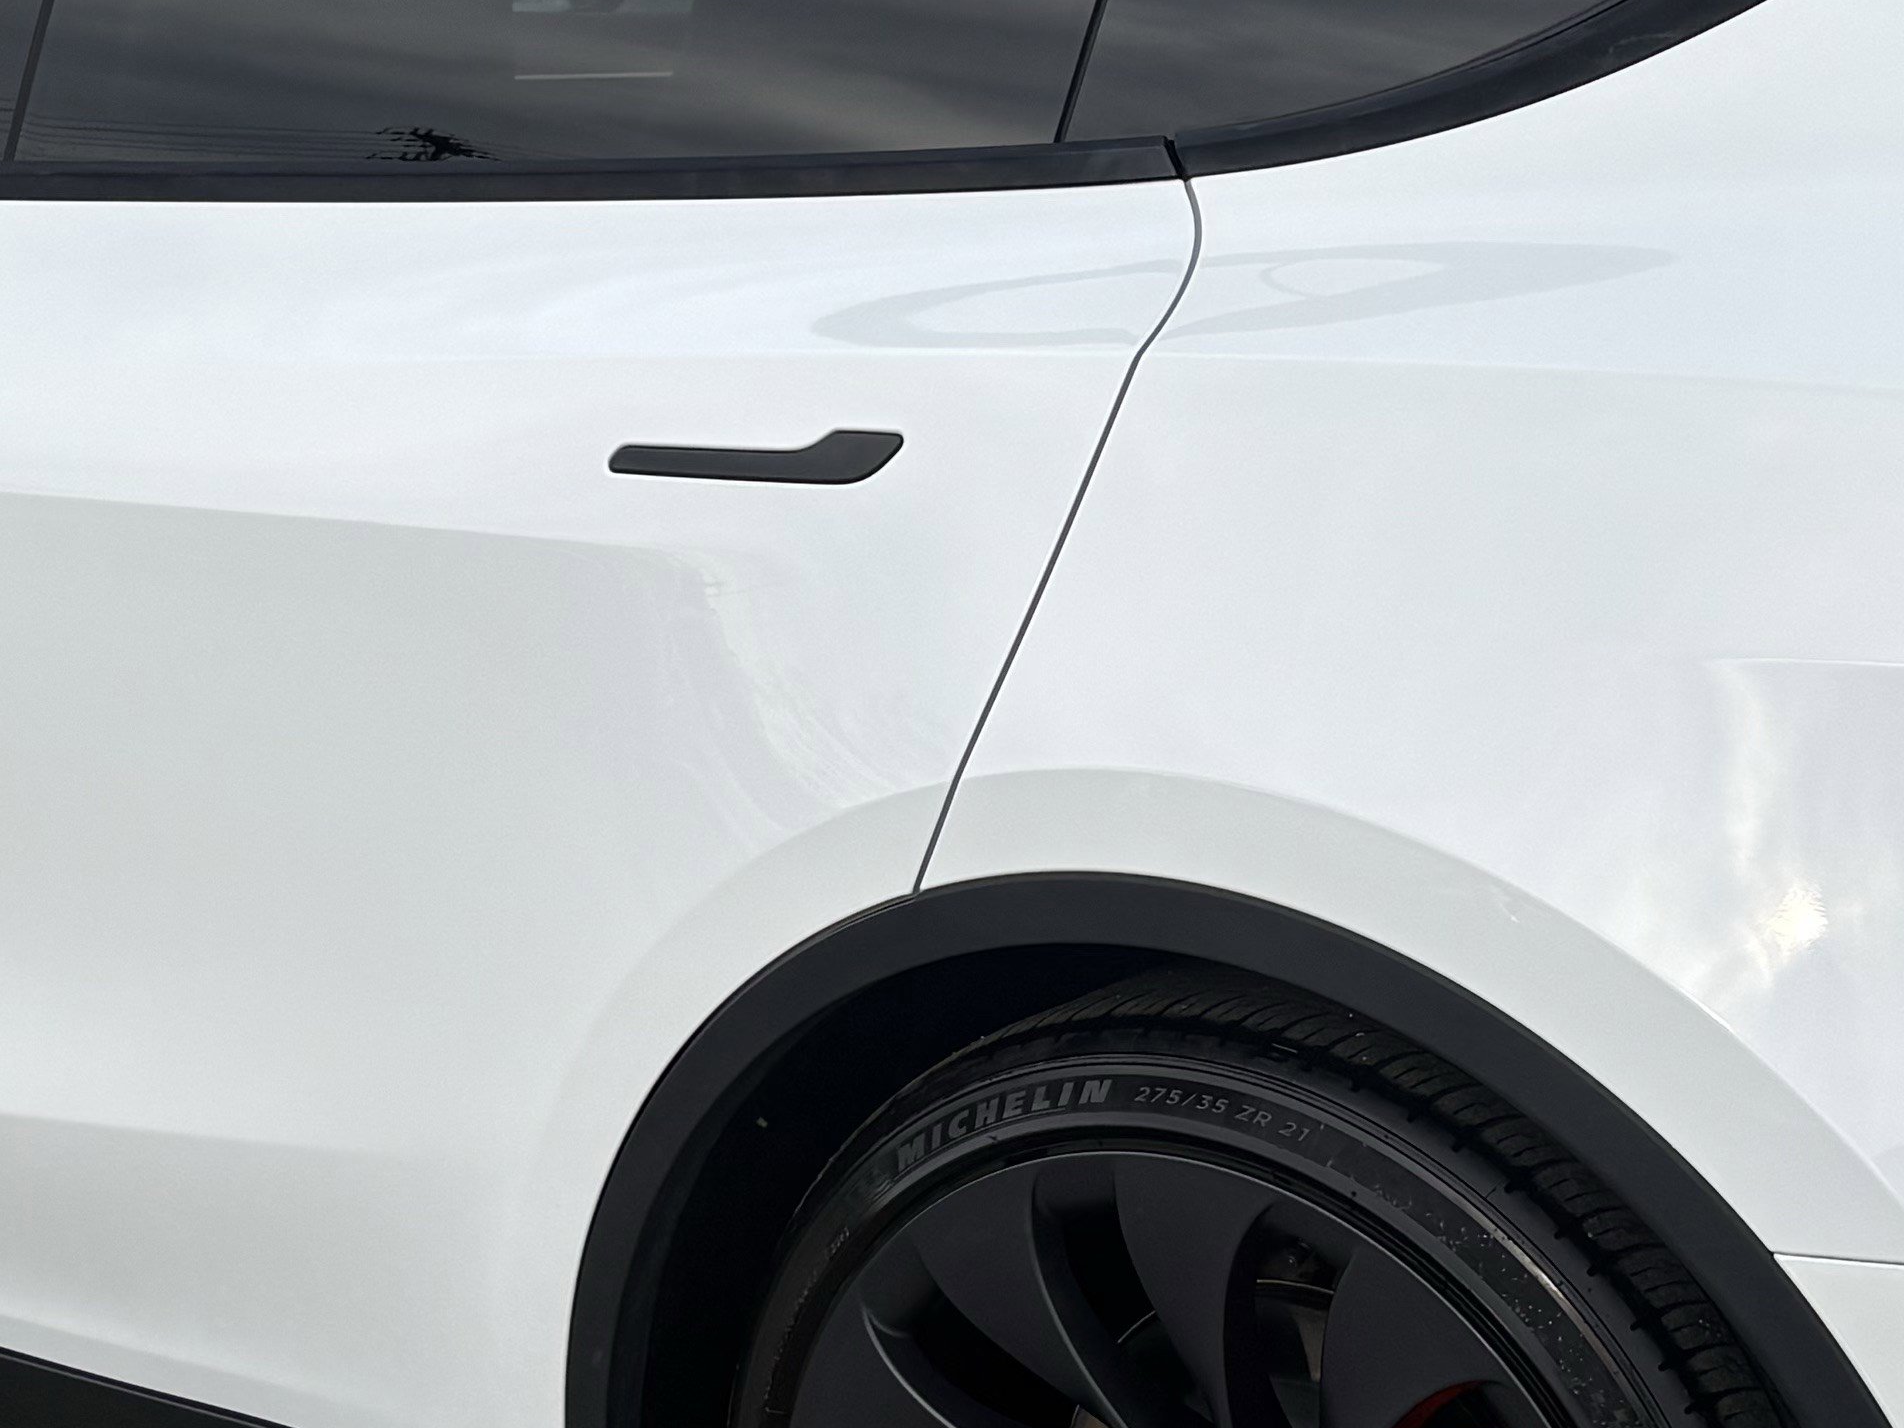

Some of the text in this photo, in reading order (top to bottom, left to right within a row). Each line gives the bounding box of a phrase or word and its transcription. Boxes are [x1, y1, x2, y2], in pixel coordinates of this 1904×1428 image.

[897, 1078, 1312, 1172] MICHELIN 275/35 ZR 21
